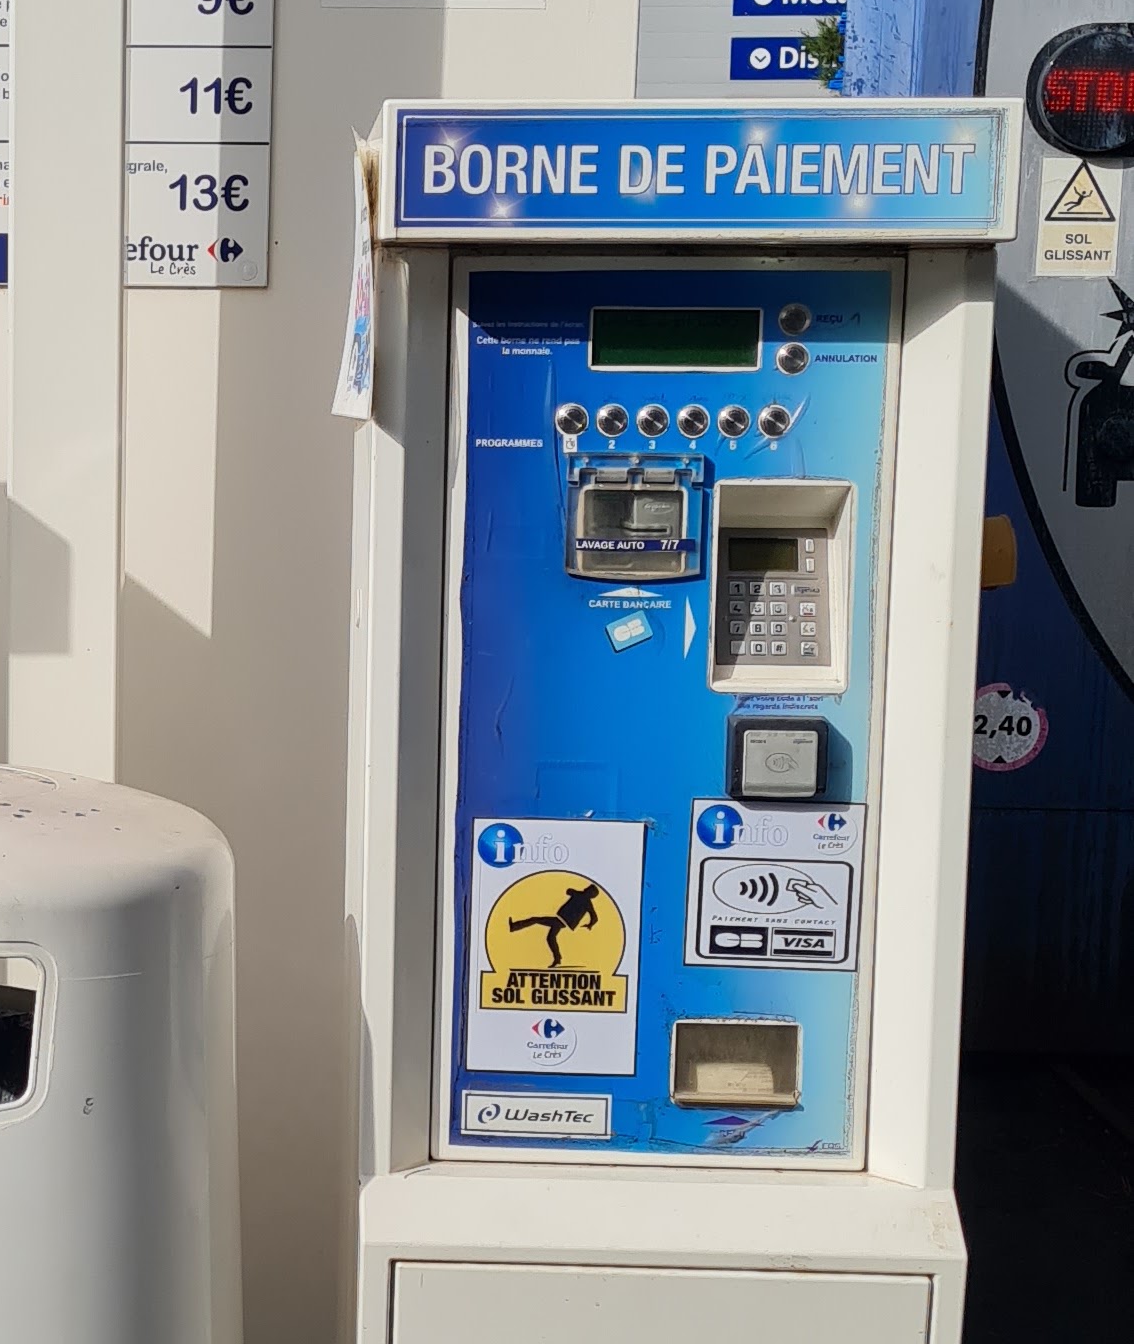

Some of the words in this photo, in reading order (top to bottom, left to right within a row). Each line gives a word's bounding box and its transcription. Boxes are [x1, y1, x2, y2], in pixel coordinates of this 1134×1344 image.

[179, 76, 253, 115] 11€
[1044, 70, 1134, 113] STO
[422, 142, 598, 196] BORNE
[618, 143, 686, 197] DE
[704, 142, 976, 196] PAIEMENT
[168, 174, 250, 212] 13€
[1065, 233, 1093, 245] SOL
[1044, 249, 1112, 262] GLISSANT
[150, 262, 165, 275] Le
[169, 261, 197, 275] Crès
[816, 313, 843, 324] REÇU
[814, 354, 878, 364] ANNULATION
[475, 438, 544, 448] PROGRAMMES
[608, 439, 617, 450] 2
[648, 439, 657, 450] 3
[689, 440, 697, 450] 4
[575, 540, 615, 550] LAVAGE
[617, 541, 645, 550] AUTO
[660, 539, 680, 550] 7/7
[588, 599, 621, 608] CARTE
[973, 714, 1033, 739] 2,40
[781, 936, 826, 949] VISA
[506, 972, 602, 991] ATTENTION
[491, 987, 526, 1004] SOL
[531, 988, 617, 1007] GLISSANT
[504, 1107, 595, 1125] WashTec
